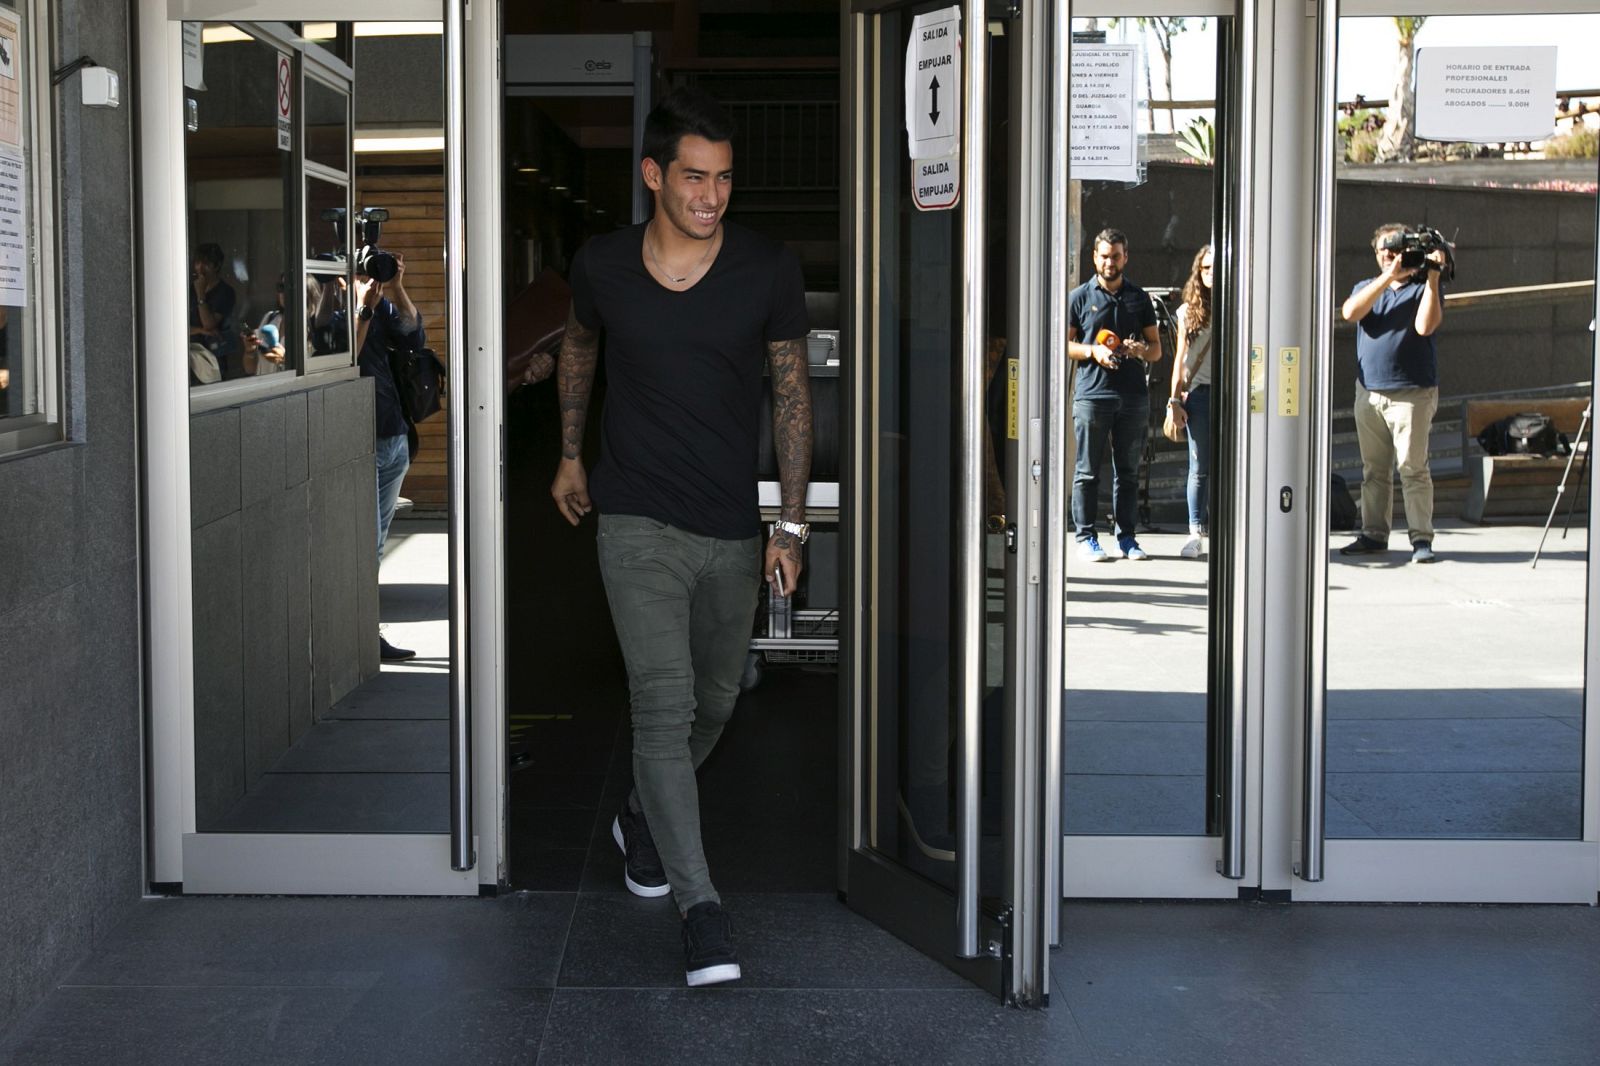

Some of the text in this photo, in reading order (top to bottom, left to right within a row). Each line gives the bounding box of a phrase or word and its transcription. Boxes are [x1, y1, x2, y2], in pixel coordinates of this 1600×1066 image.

[922, 26, 948, 42] SALIDA
[918, 54, 952, 70] EMPUJAR
[922, 162, 949, 176] SALIDA
[919, 182, 954, 198] EMPUJAR
